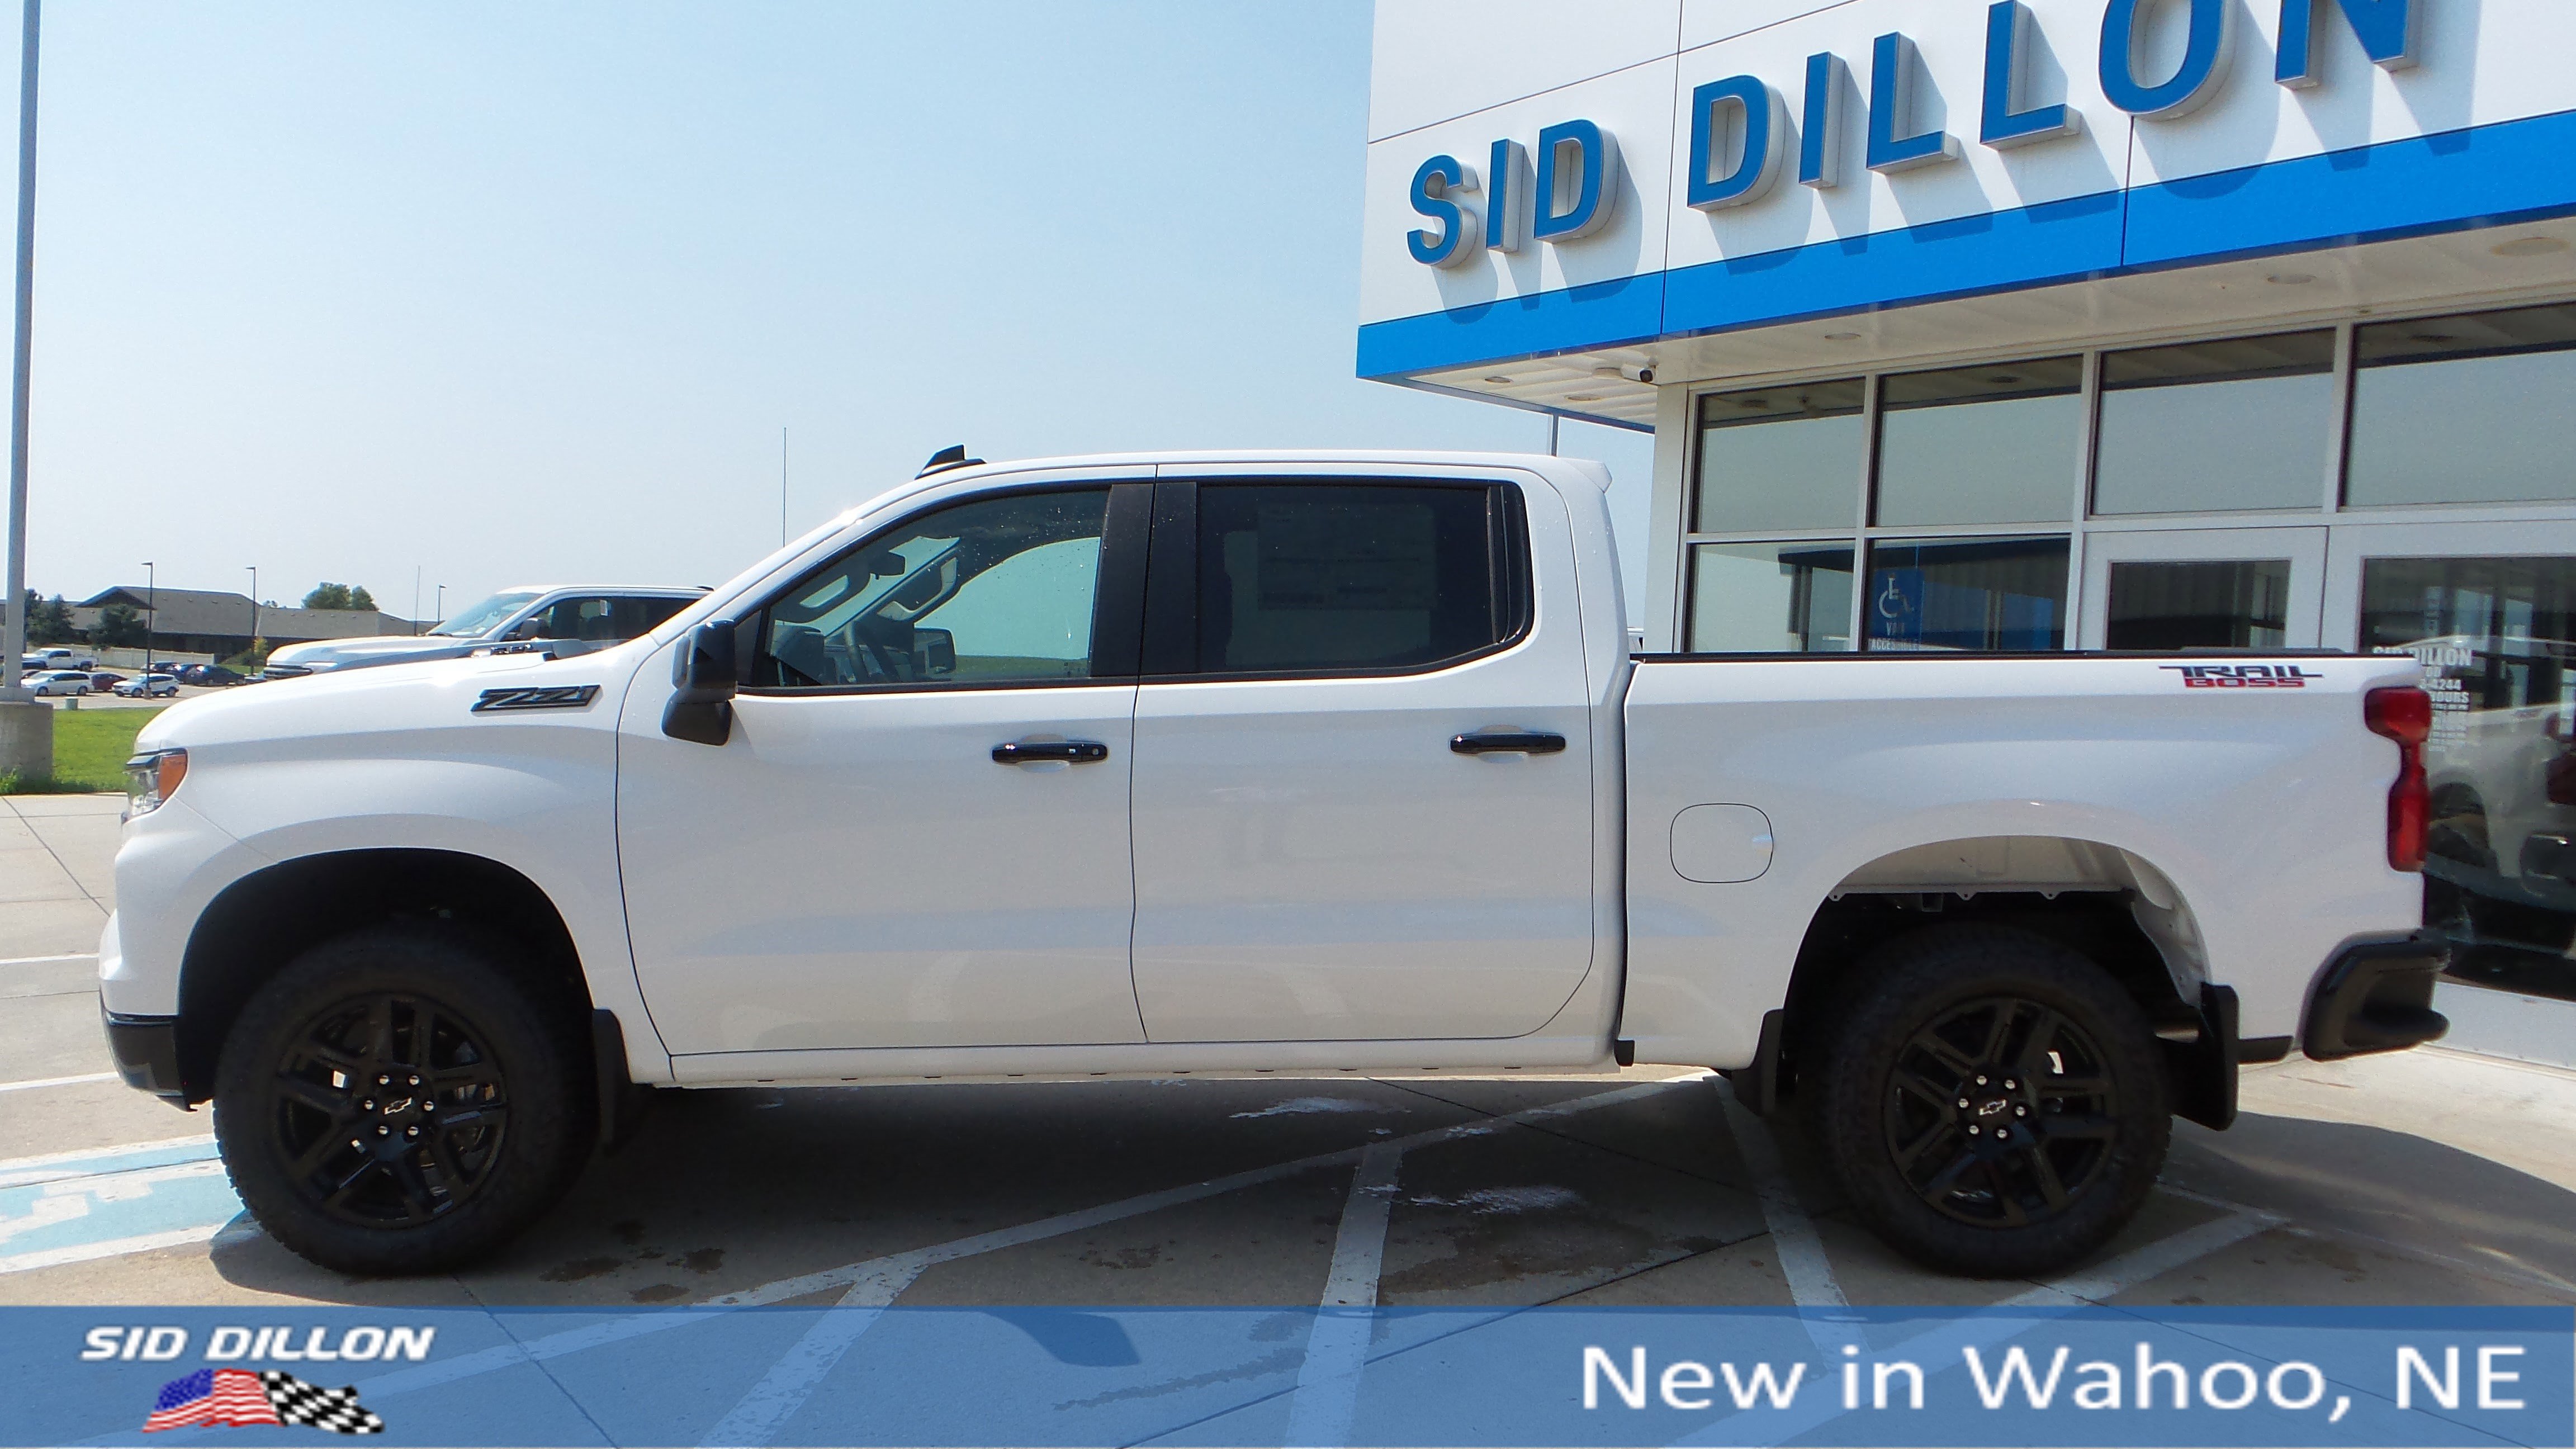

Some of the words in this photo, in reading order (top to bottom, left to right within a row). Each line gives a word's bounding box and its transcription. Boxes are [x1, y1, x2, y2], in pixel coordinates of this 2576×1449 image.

[1407, 119, 1620, 268] SID
[2158, 665, 2323, 678] TRAIL
[2185, 677, 2304, 688] BOSS
[470, 684, 600, 711] Z71
